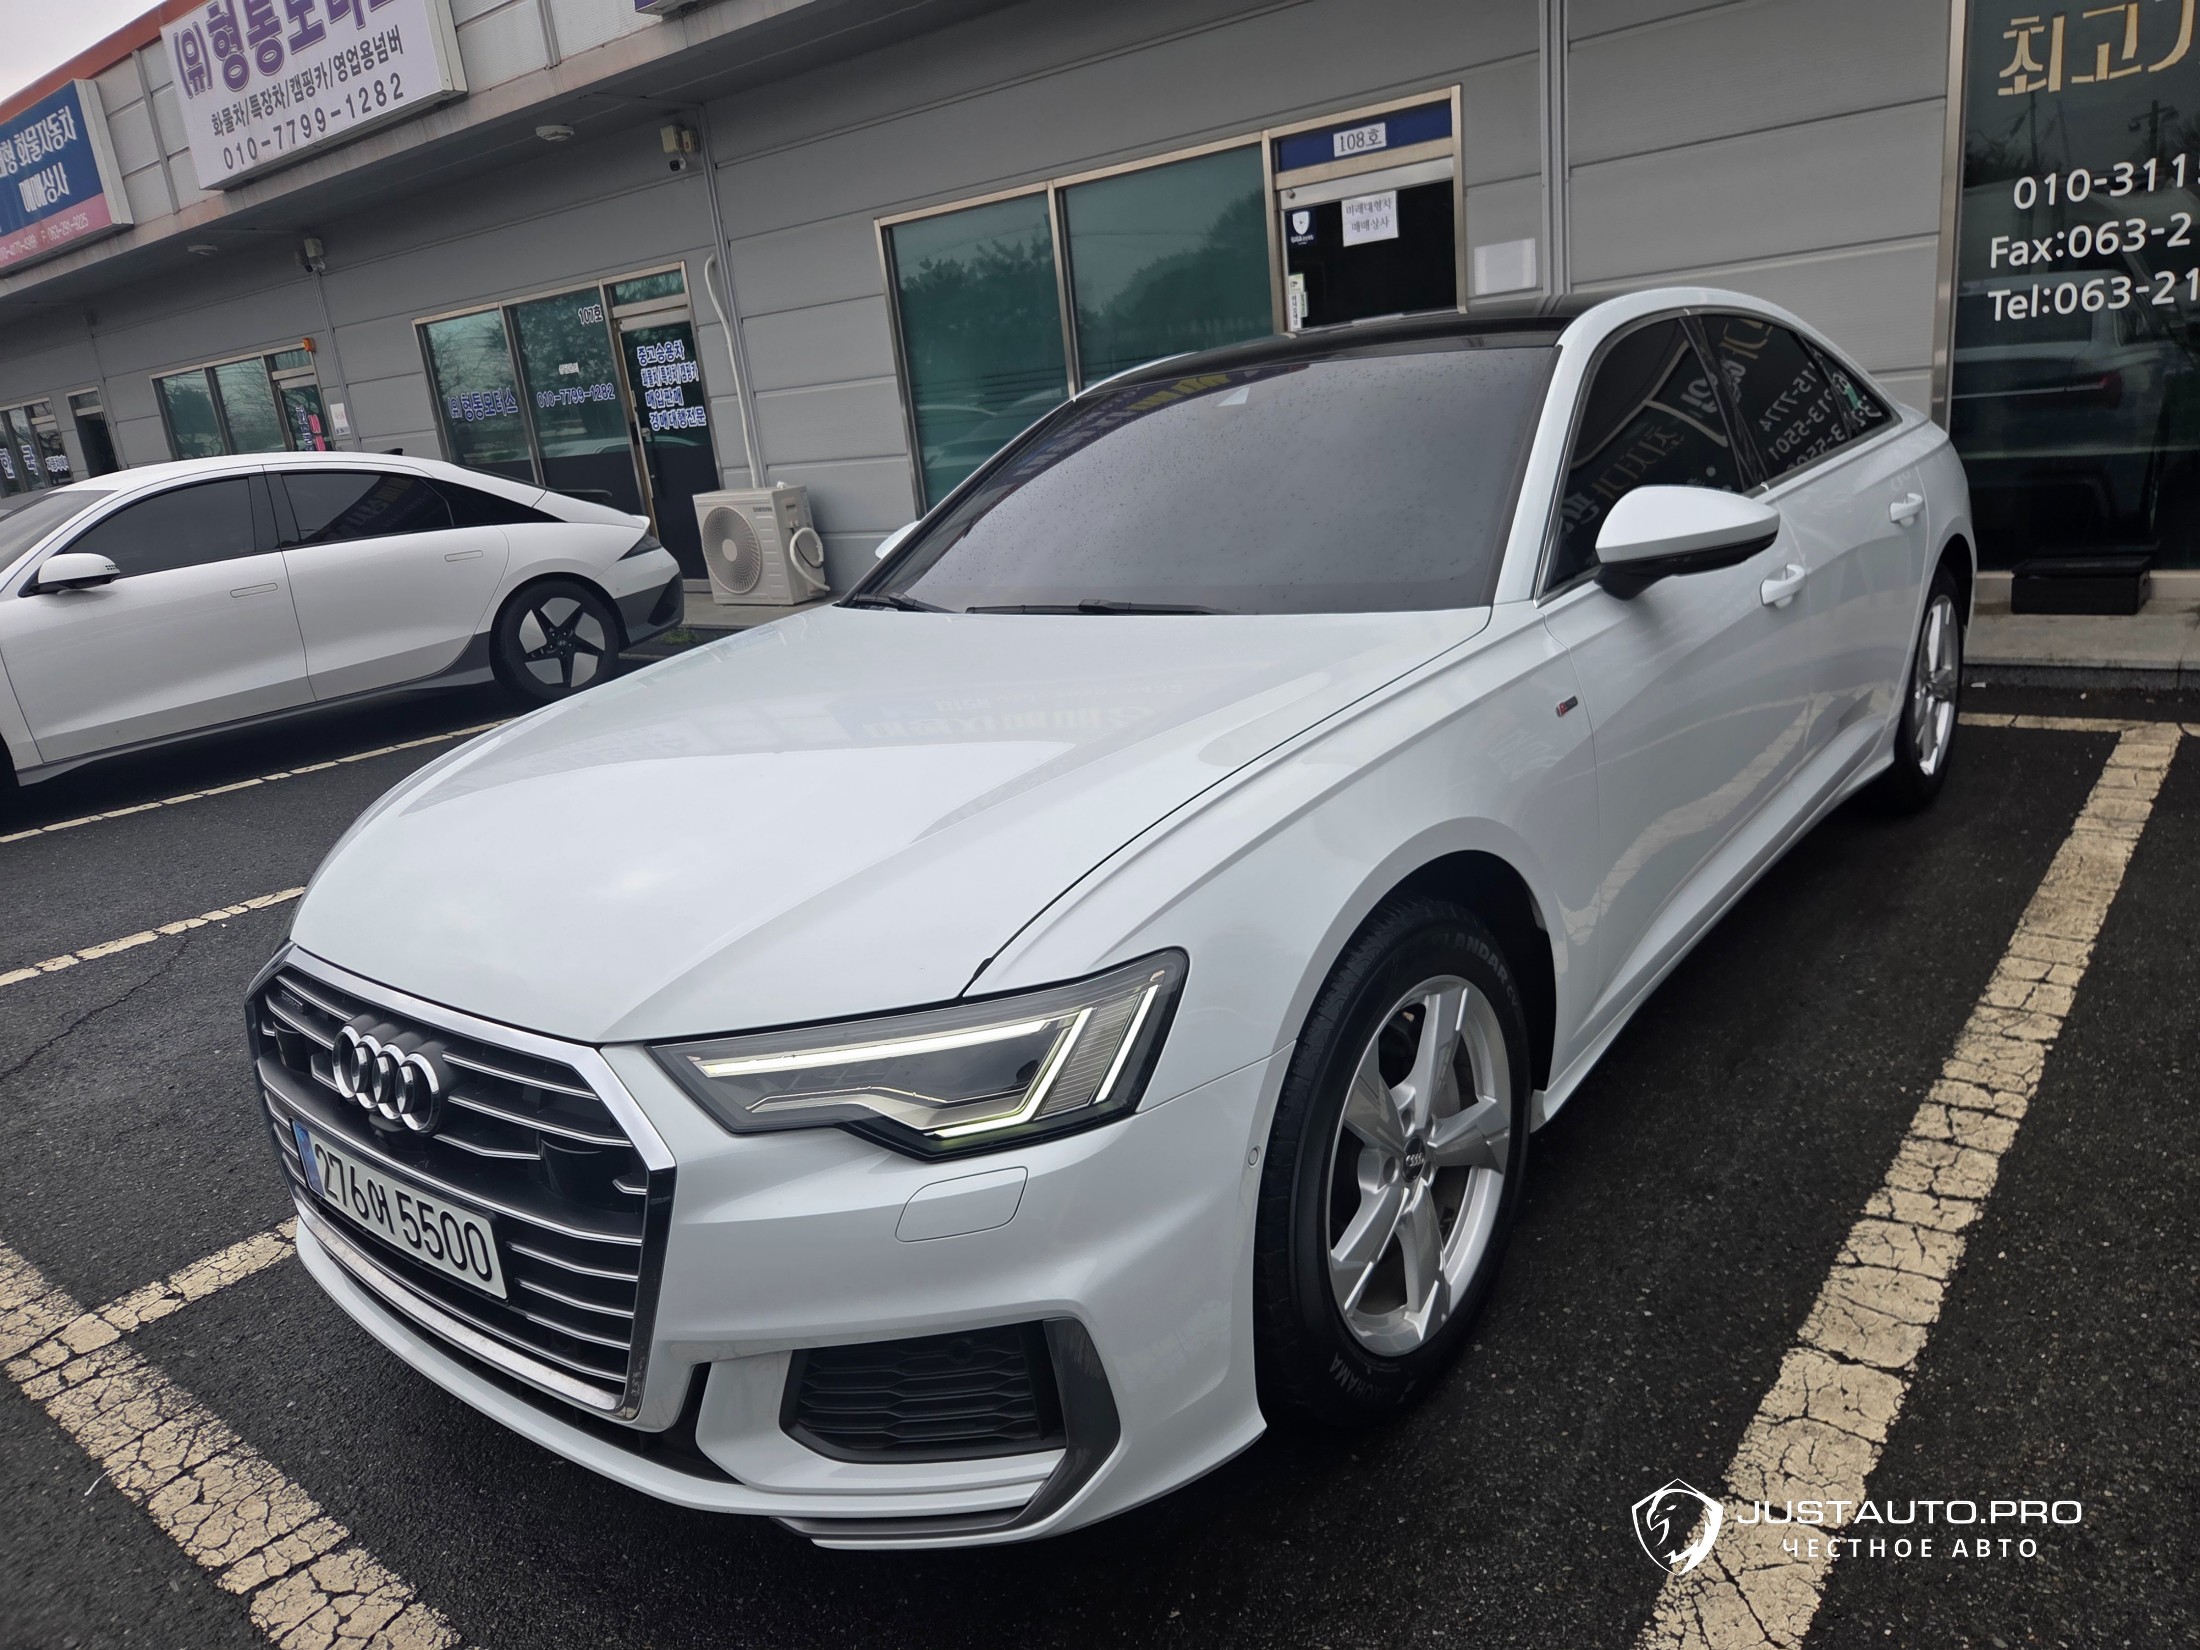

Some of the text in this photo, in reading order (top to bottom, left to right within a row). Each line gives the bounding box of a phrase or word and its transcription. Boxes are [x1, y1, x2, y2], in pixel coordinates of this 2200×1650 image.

[172, 0, 398, 99] (유)형동모
[210, 25, 404, 137] 화물차/특장차/캠핑카/영업용넘버
[222, 72, 405, 170] 010-7799-1282
[1339, 128, 1383, 153] 108호
[2013, 153, 2200, 210] 010-311
[578, 304, 605, 326] 107호
[636, 339, 685, 366] 중고승용차
[536, 382, 616, 408] 010-7799-1282
[644, 386, 685, 410] 매입판매
[649, 405, 707, 431] 경매대행전문
[313, 1141, 494, 1283] 276어 5500
